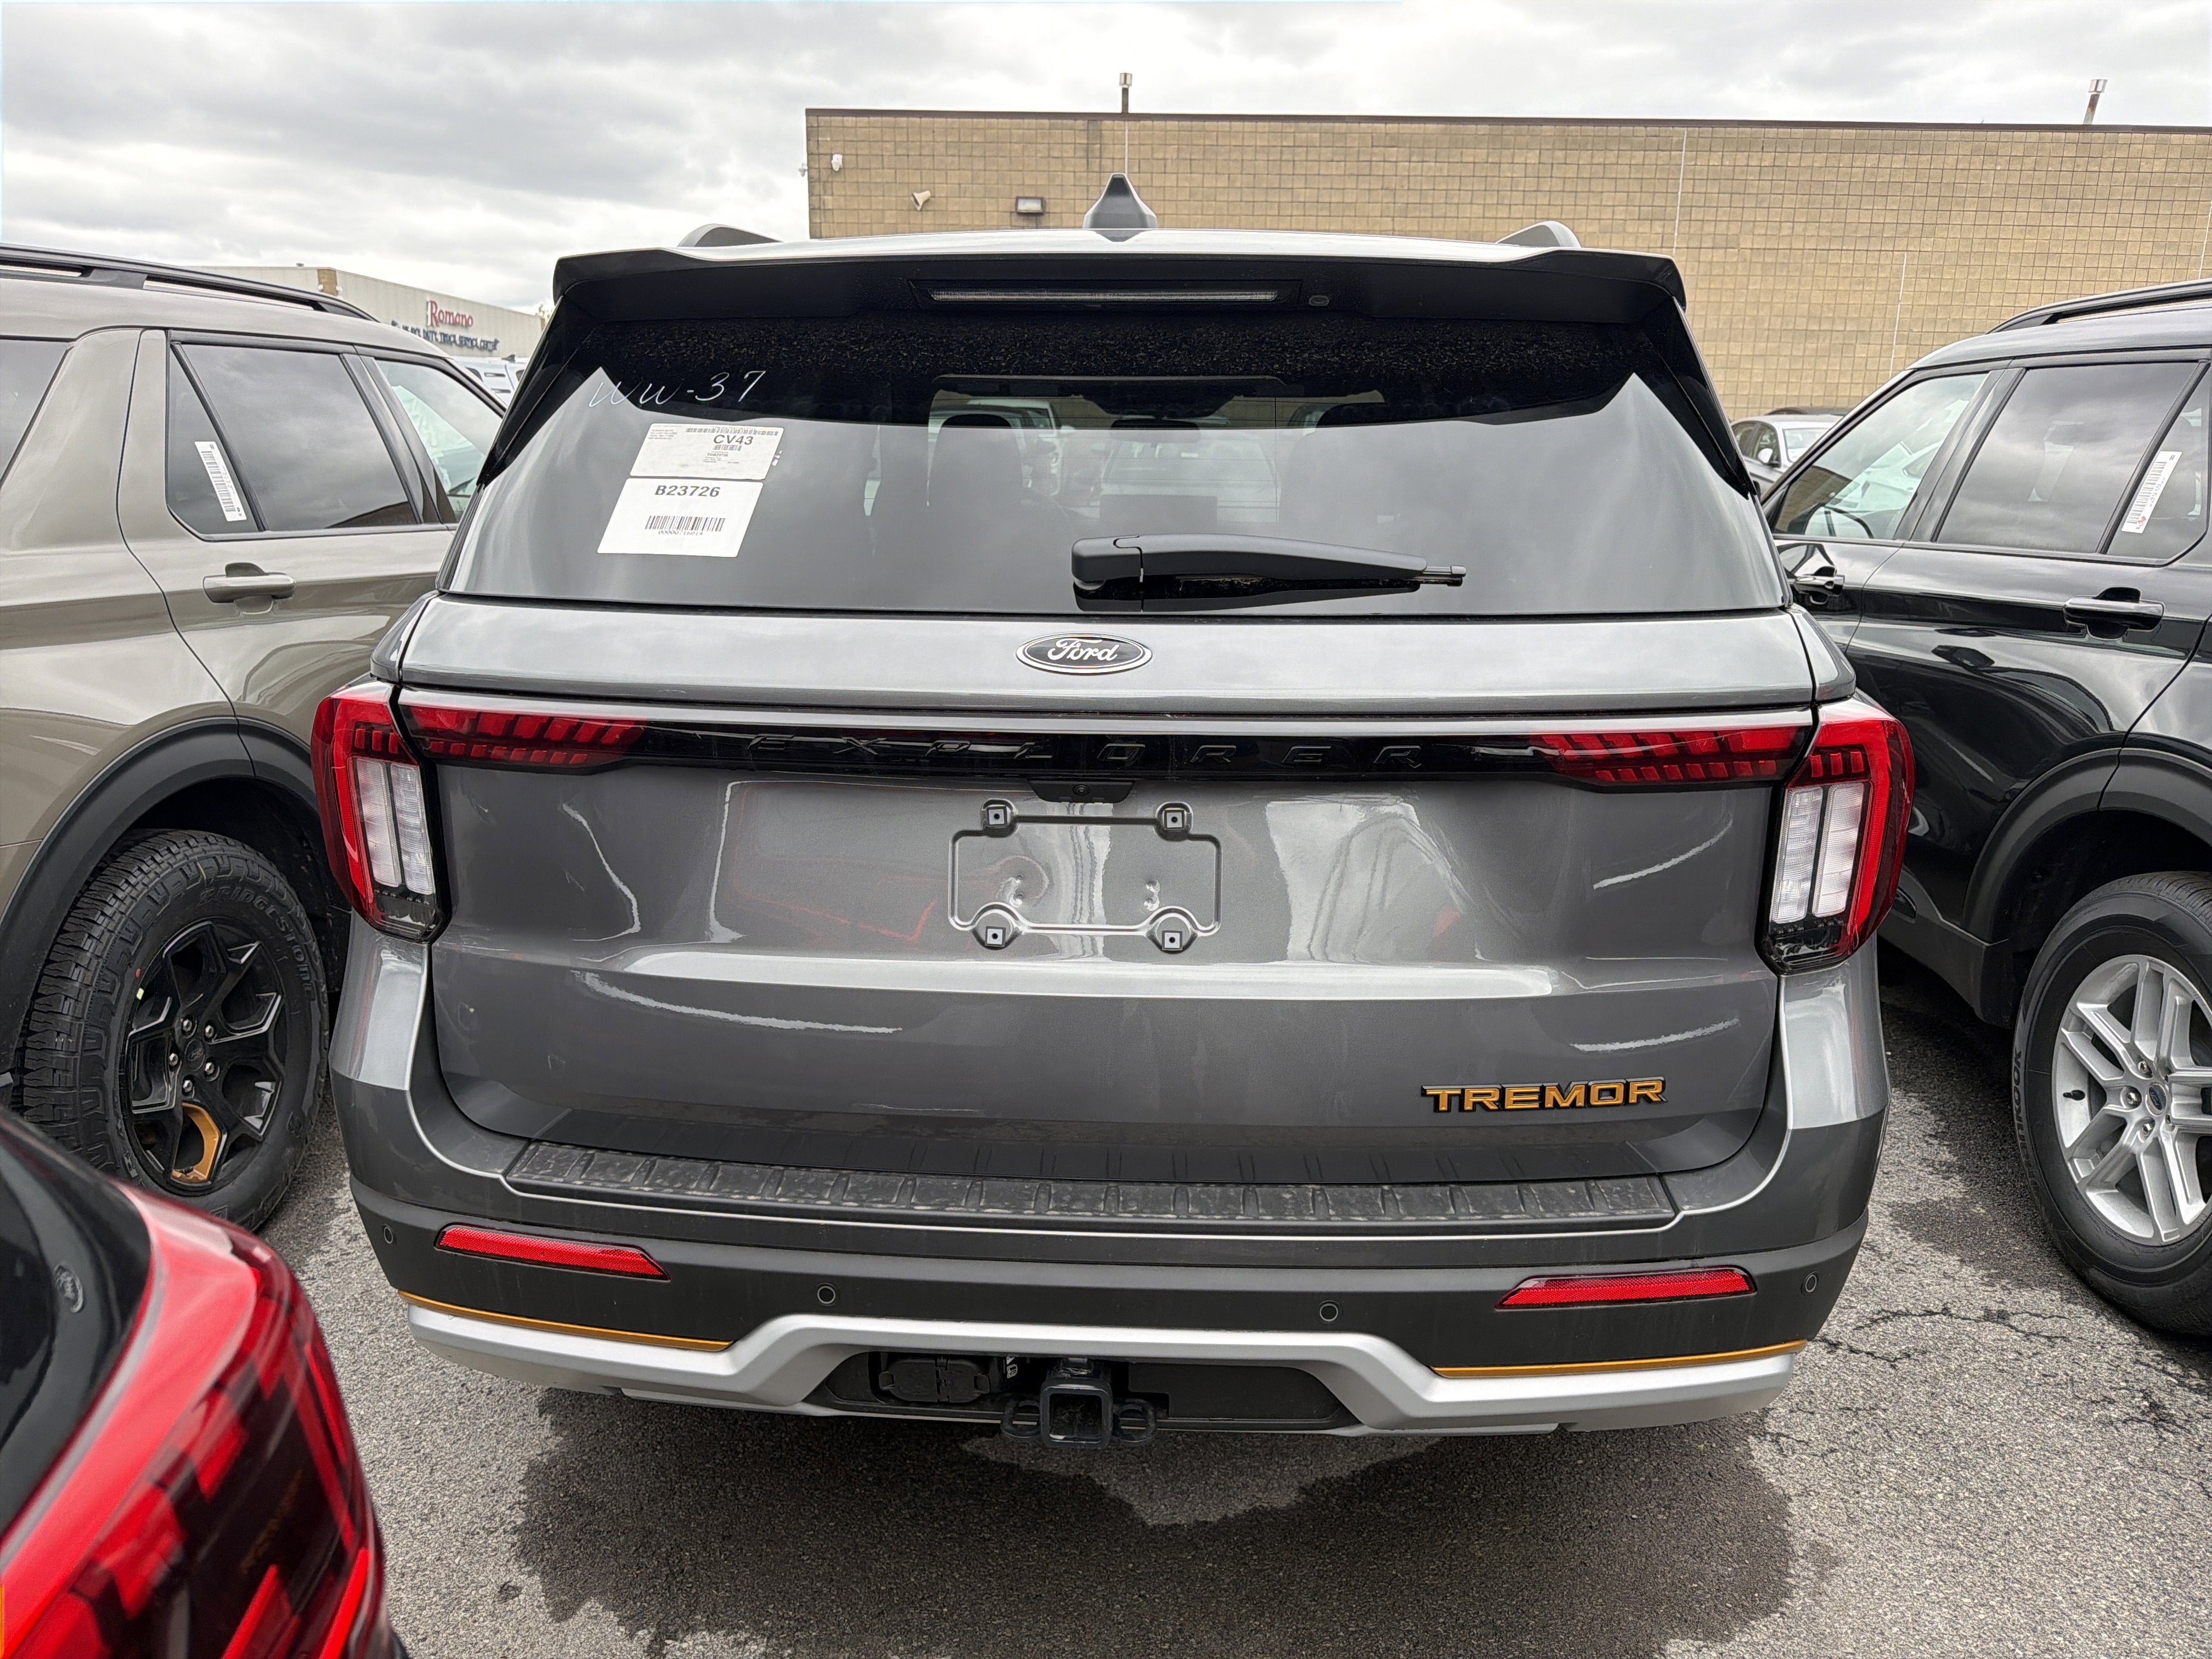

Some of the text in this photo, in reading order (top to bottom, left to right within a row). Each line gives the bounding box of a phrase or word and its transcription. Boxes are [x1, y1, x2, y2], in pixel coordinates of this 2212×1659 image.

[426, 300, 473, 328] Romano
[713, 434, 754, 445] CV43
[654, 485, 721, 498] B23726
[1047, 637, 1121, 662] Ford
[745, 733, 1423, 768] EXPLORER
[1421, 1076, 1668, 1113] TREMOR
